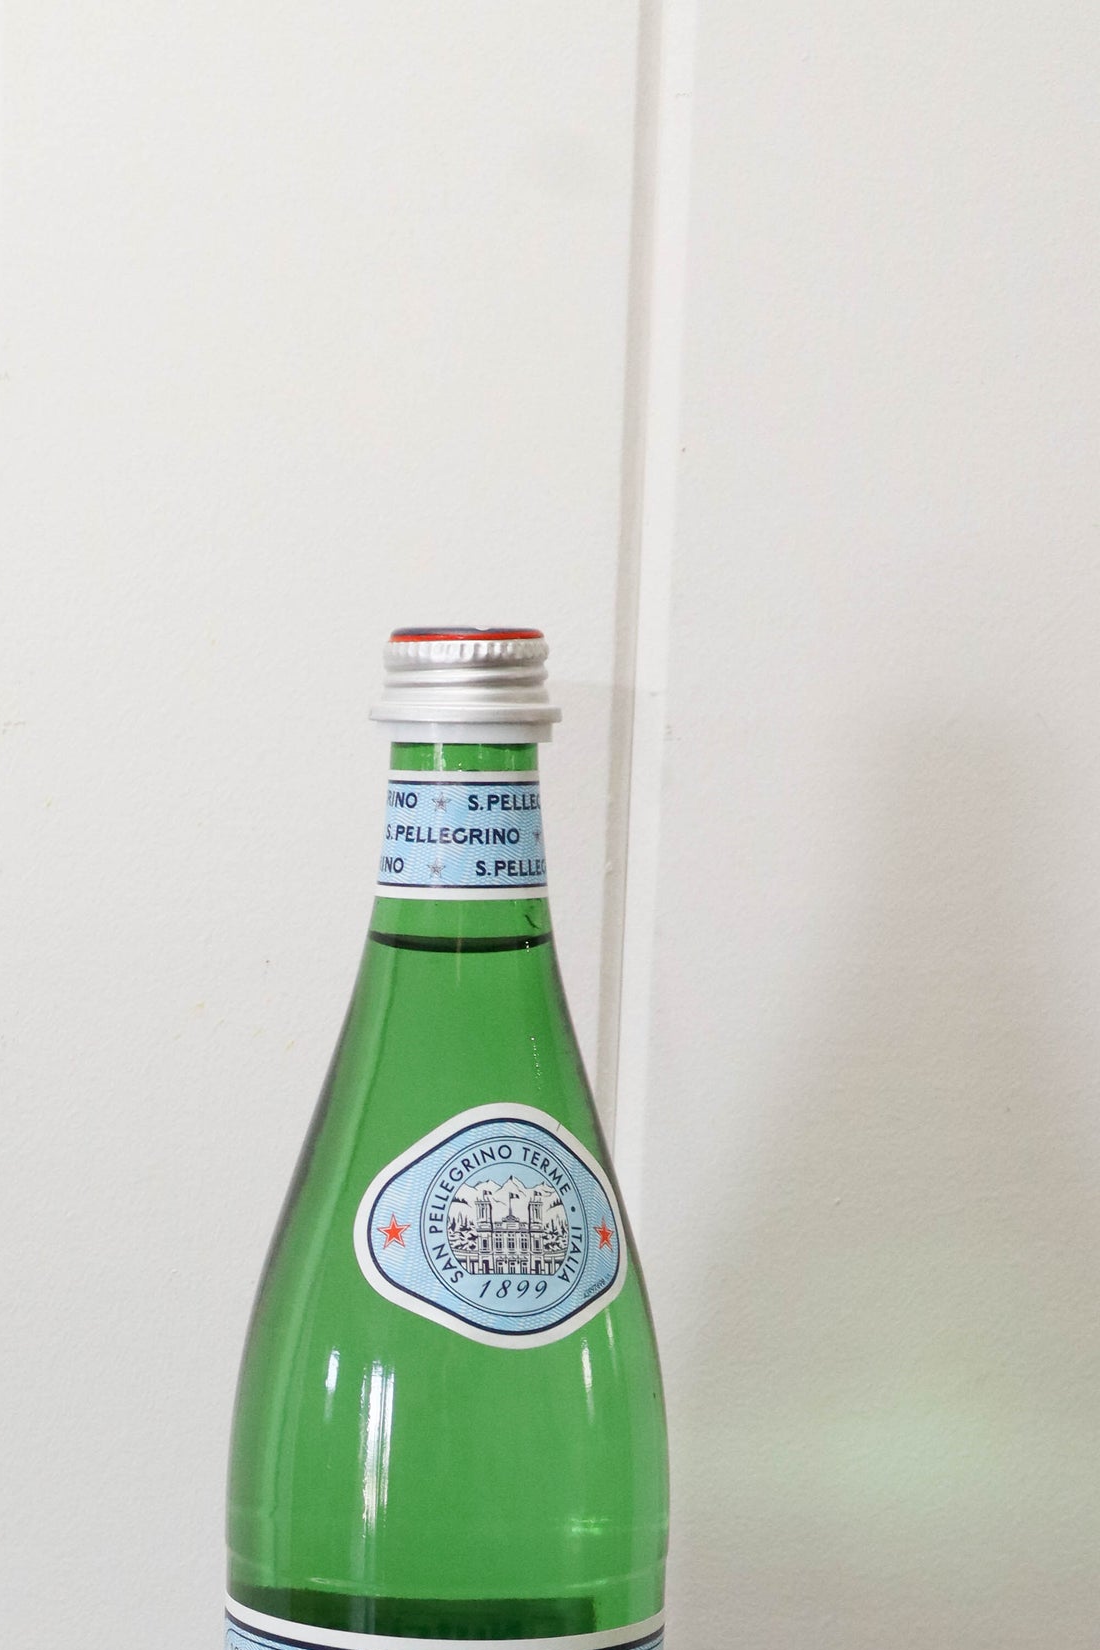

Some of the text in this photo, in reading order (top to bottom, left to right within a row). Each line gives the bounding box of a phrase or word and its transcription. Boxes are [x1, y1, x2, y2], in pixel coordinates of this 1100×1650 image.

[429, 1144, 582, 1284] SAN PELLEGRINO TERME ITALIA
[479, 1280, 548, 1299] 1899
